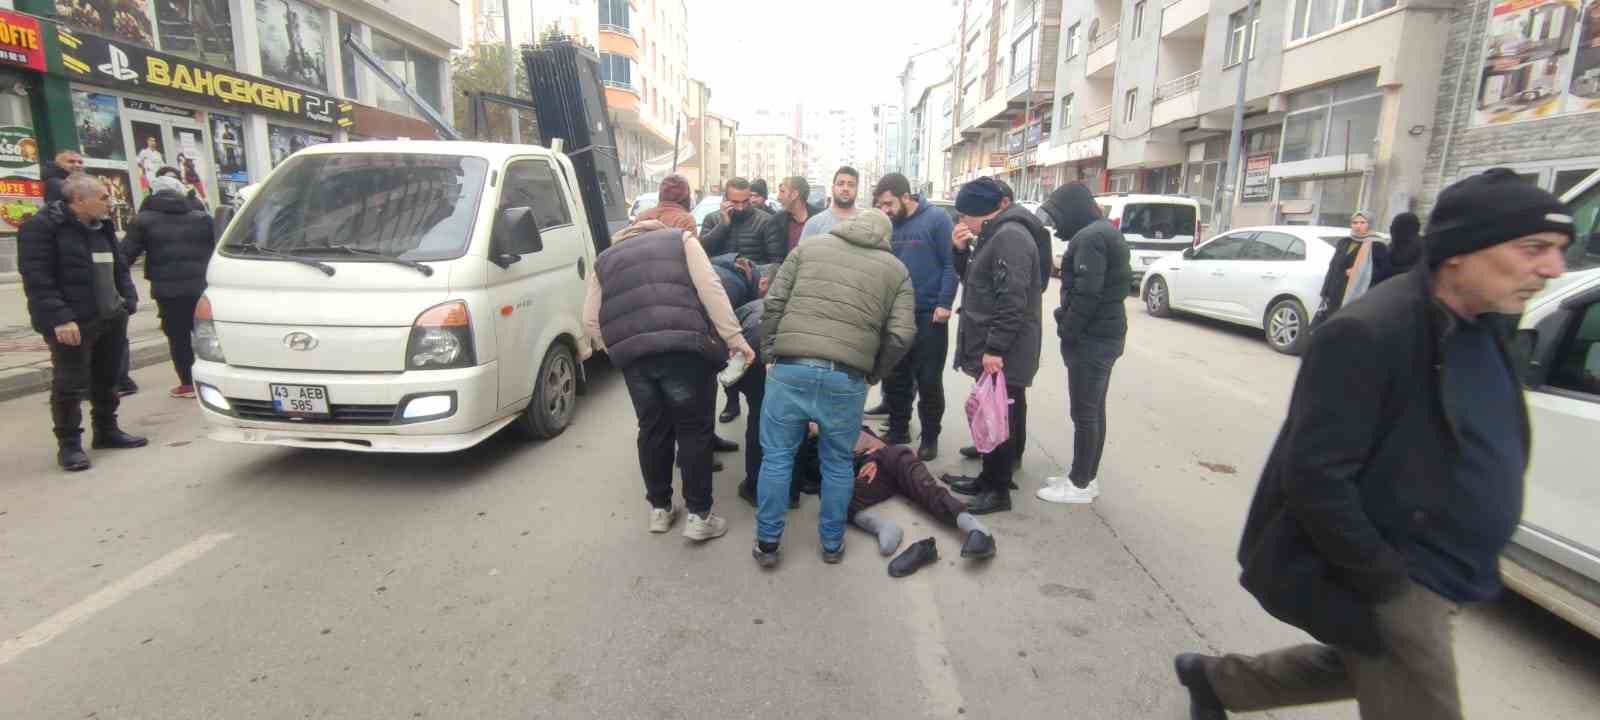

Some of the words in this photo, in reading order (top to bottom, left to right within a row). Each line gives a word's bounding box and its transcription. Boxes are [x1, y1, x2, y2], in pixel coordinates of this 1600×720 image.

[146, 56, 302, 113] BAHÇEKENT
[274, 386, 289, 398] 43
[299, 387, 323, 400] AEB
